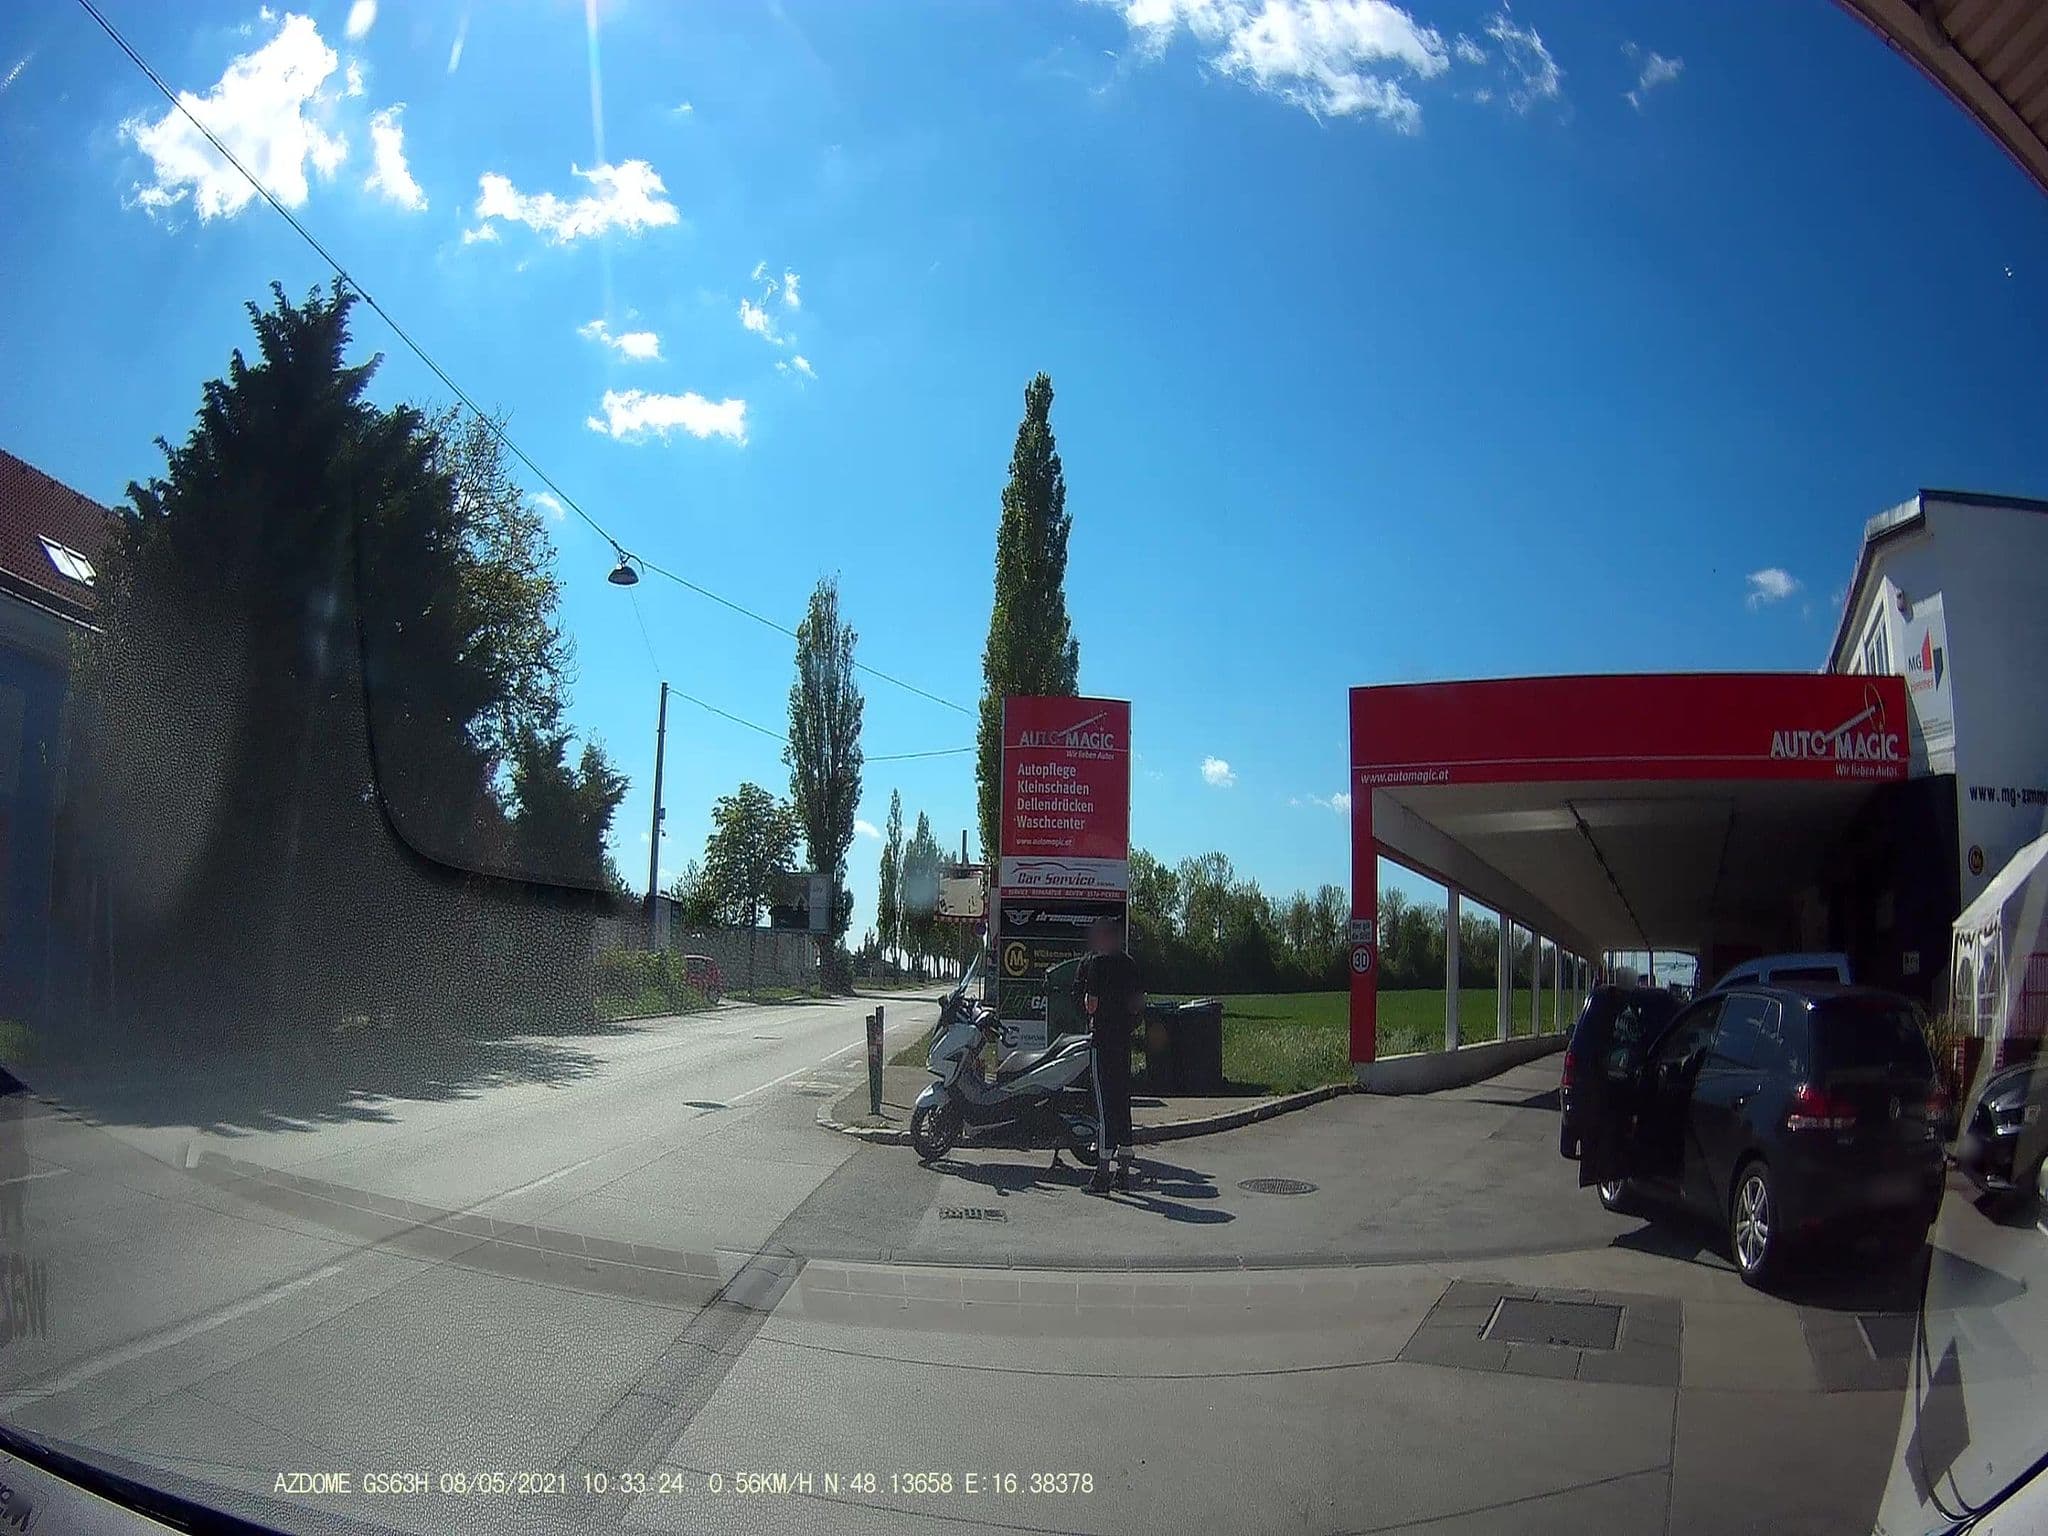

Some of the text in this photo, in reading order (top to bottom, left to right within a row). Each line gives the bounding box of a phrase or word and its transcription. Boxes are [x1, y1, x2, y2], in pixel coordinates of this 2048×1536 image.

[1065, 731, 1114, 748] MAGIC
[1770, 729, 1898, 760] AUTO MAGIC
[1017, 762, 1077, 779] Autopflege
[1361, 768, 1449, 784] www.automagic.at
[1017, 780, 1090, 796] Kleinschaden
[1016, 797, 1094, 813] Dellendrücken
[1016, 815, 1086, 830] Waschcenter
[1045, 873, 1095, 886] Service
[1354, 952, 1369, 969] 30
